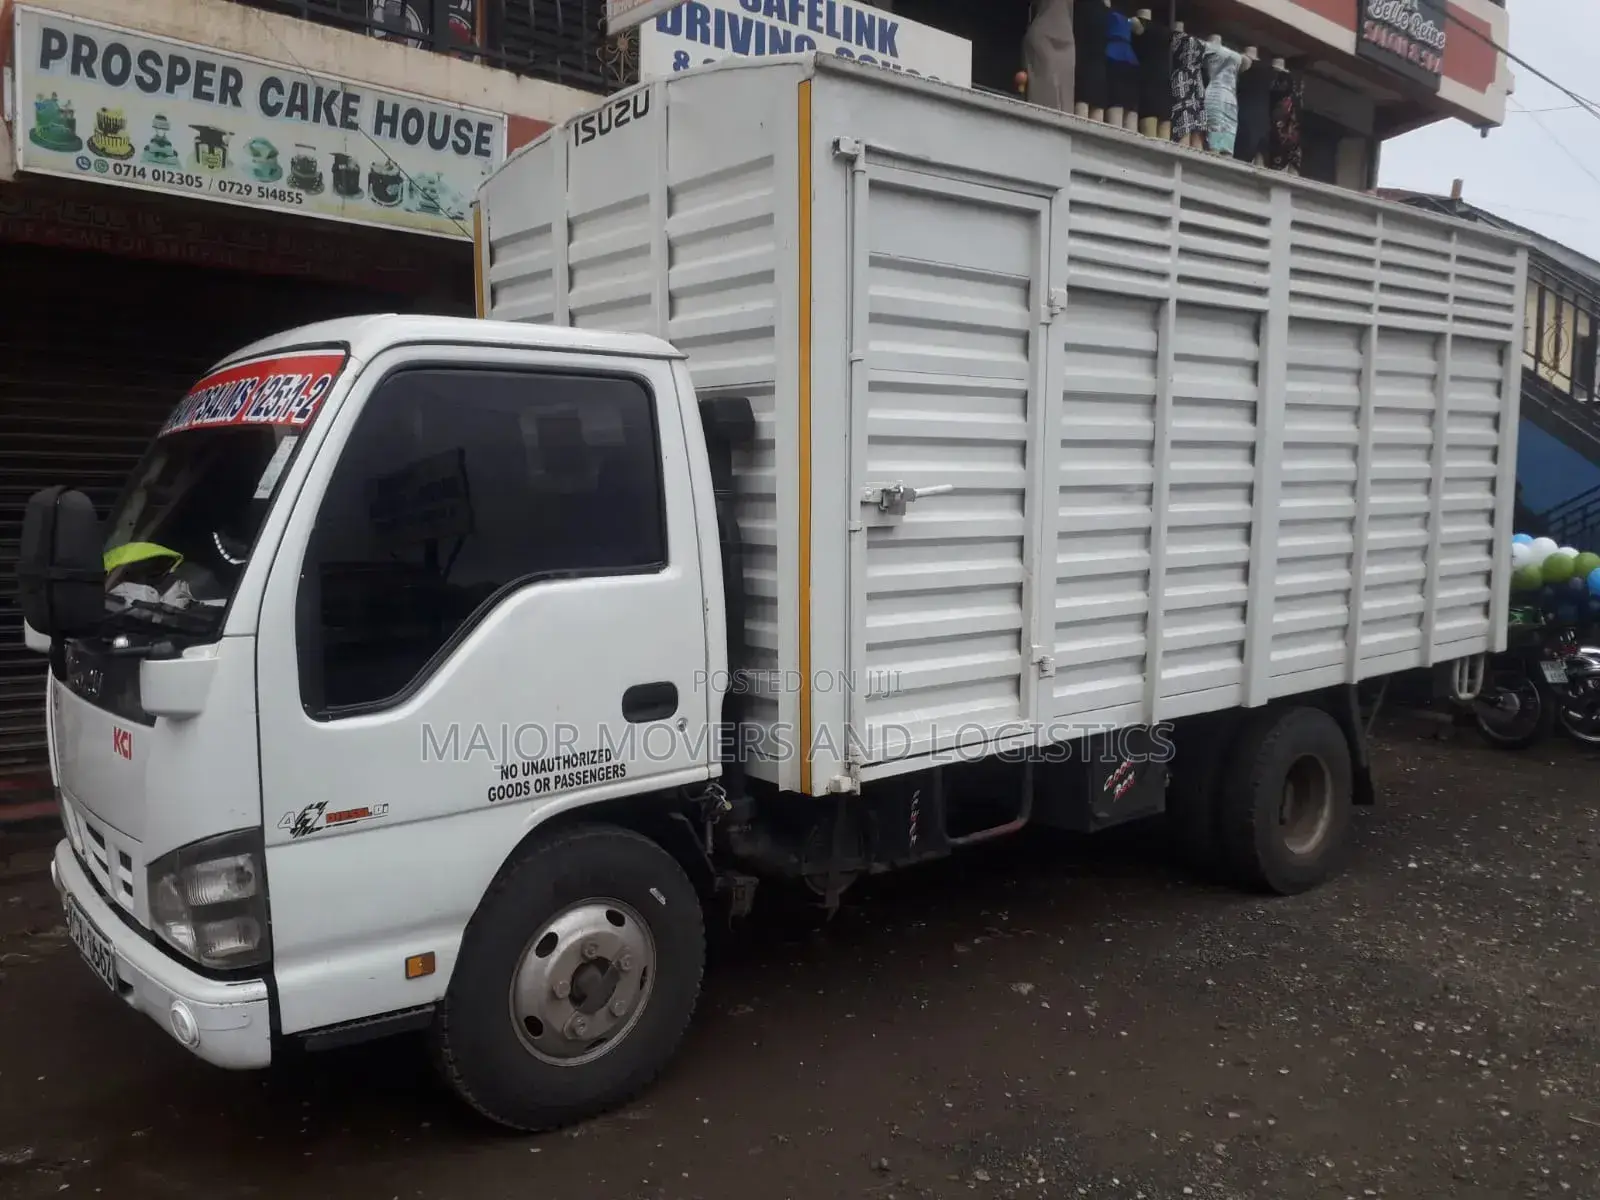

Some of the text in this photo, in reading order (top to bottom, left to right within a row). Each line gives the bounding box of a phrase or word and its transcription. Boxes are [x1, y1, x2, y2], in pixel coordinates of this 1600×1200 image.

[40, 27, 494, 157] PROSPER CAKE HOUSE
[574, 89, 650, 147] ISUZU
[113, 162, 147, 179] 0714
[152, 169, 203, 188] 012305
[218, 180, 252, 196] 0729
[257, 186, 304, 205] 514855
[487, 763, 627, 802] GOODS OR PASSENGERS
[500, 748, 612, 780] NO UNAUTHORIZED
